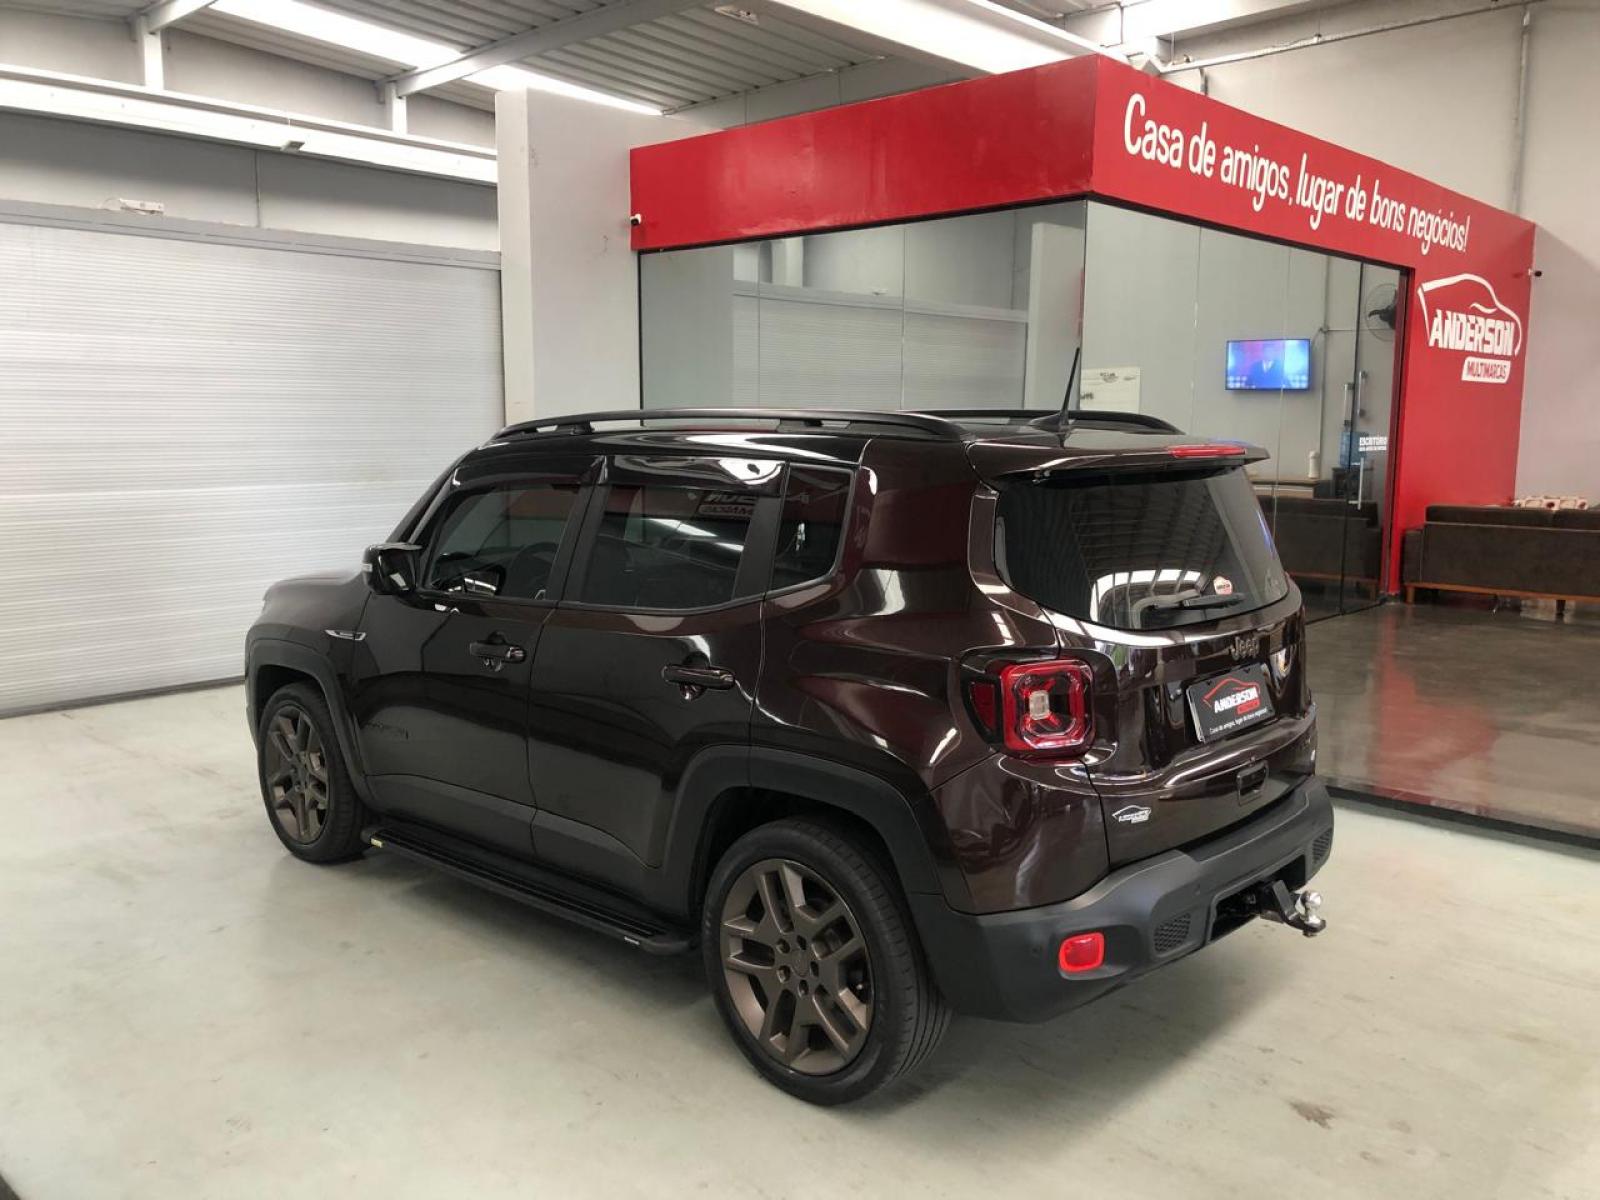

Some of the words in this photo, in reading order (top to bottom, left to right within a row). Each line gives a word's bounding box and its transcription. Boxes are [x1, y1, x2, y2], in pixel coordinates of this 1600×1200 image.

[1124, 93, 1185, 169] Casa
[1188, 121, 1216, 178] de
[1220, 144, 1294, 212] amigos,
[1296, 152, 1345, 231] lugar
[1345, 174, 1367, 222] de
[1369, 179, 1407, 232] bons
[1407, 205, 1471, 256] negócios!
[1428, 308, 1516, 356] ANDERSON
[1466, 360, 1508, 380] MULTIMARCAS
[1230, 635, 1260, 660] Jeep
[1214, 686, 1260, 714] ANDERSON
